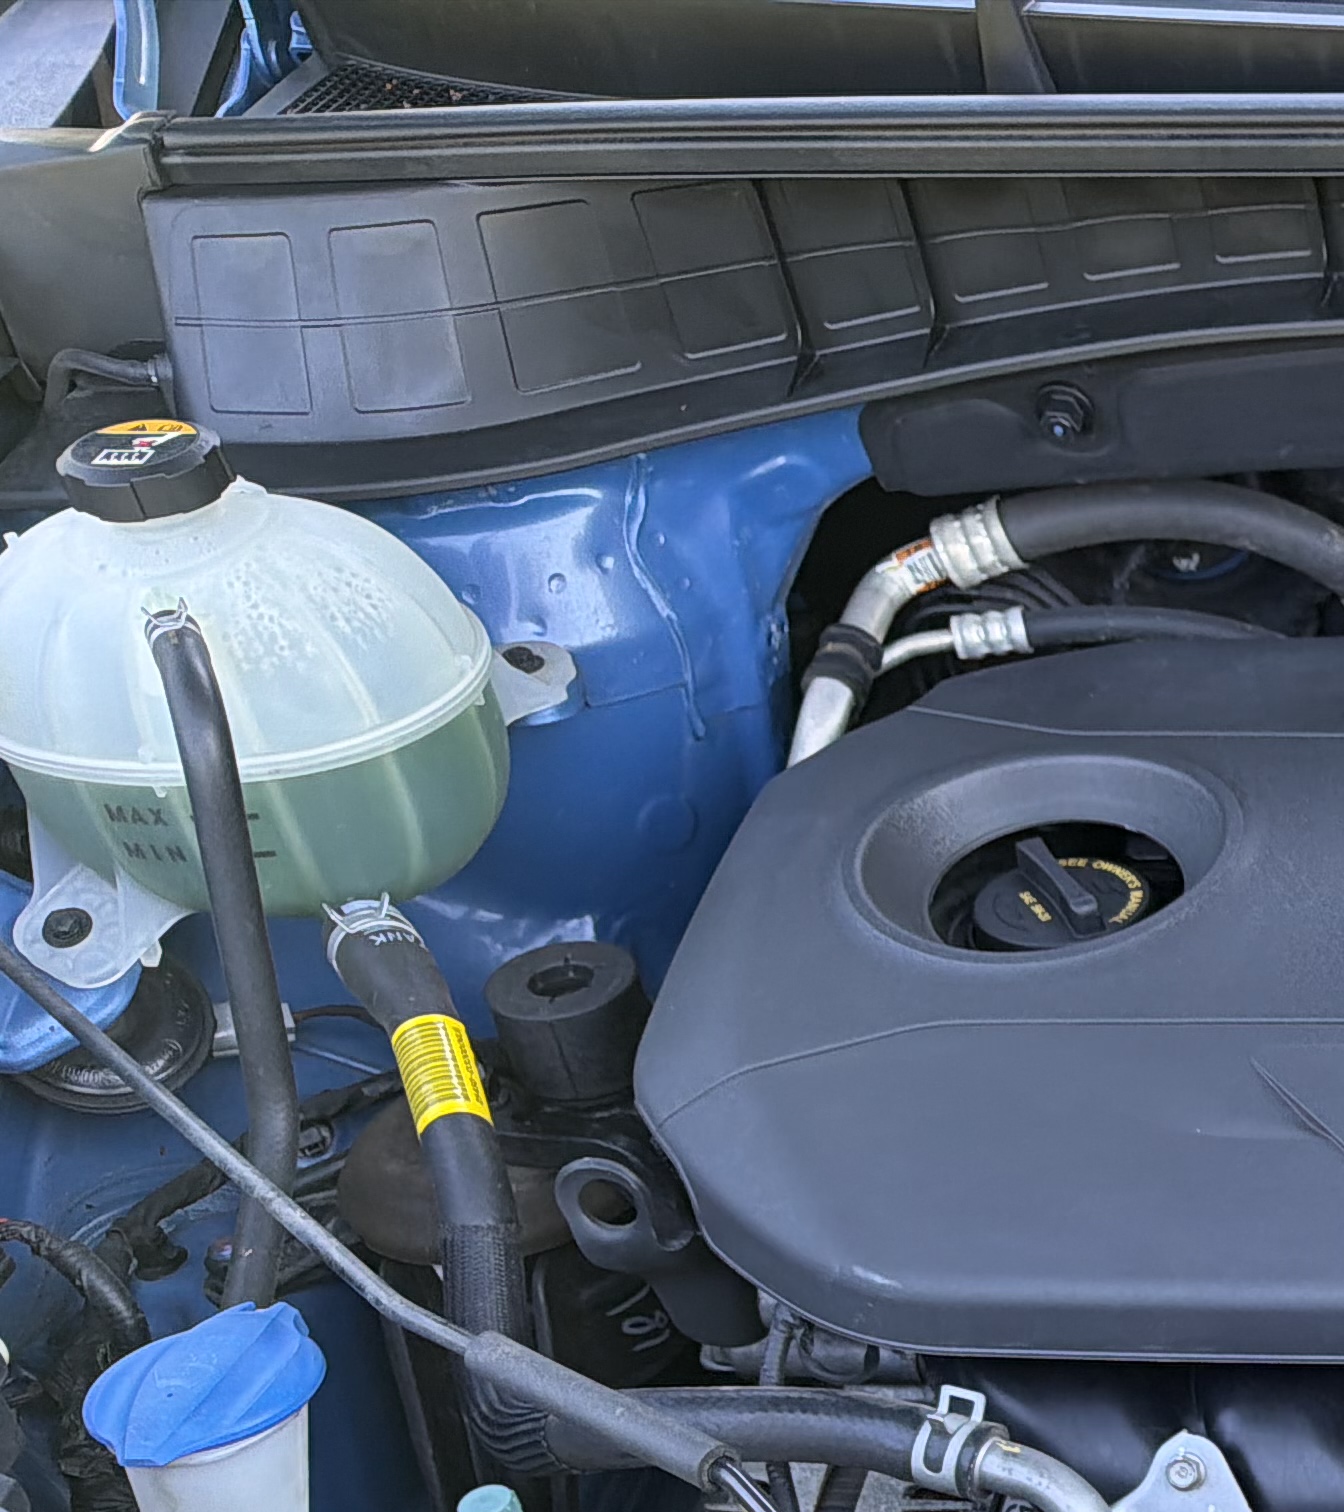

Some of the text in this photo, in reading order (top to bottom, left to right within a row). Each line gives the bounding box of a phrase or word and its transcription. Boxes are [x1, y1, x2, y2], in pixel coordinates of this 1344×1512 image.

[104, 804, 168, 827] MAX
[123, 841, 188, 863] MIN
[368, 930, 416, 946] ANK
